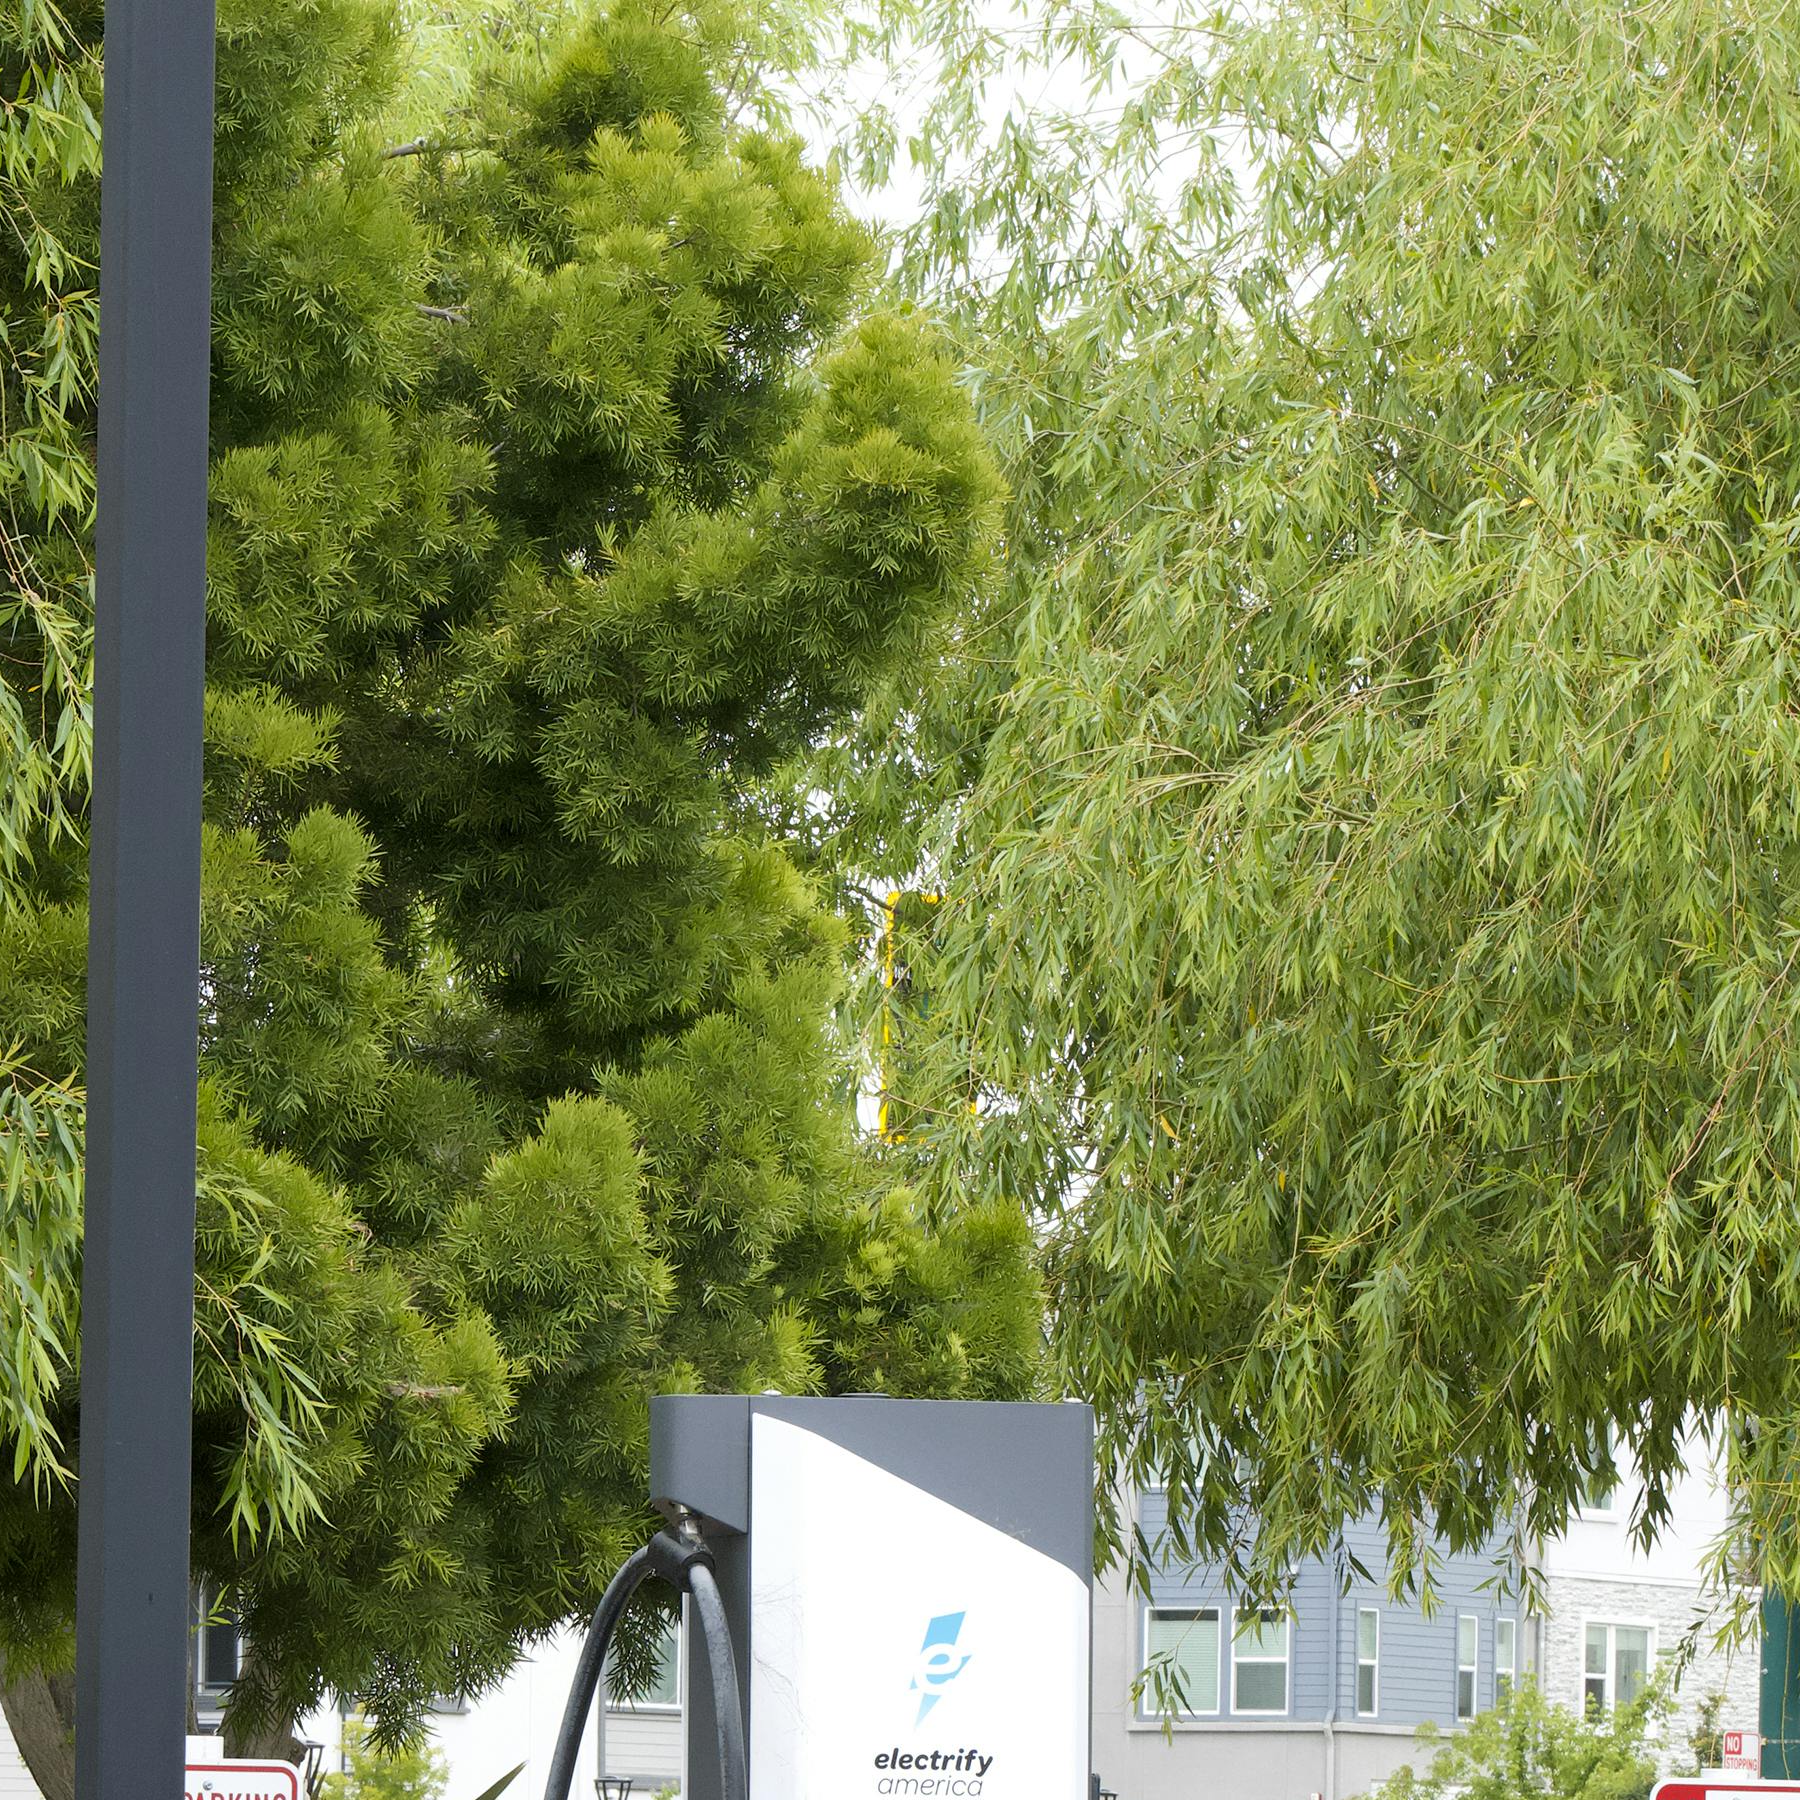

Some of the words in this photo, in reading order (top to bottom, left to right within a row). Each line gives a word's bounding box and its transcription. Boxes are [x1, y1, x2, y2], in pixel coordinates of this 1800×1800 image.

[1726, 1736, 1741, 1752] NO
[874, 1747, 993, 1777] electrify
[877, 1775, 983, 1796] america
